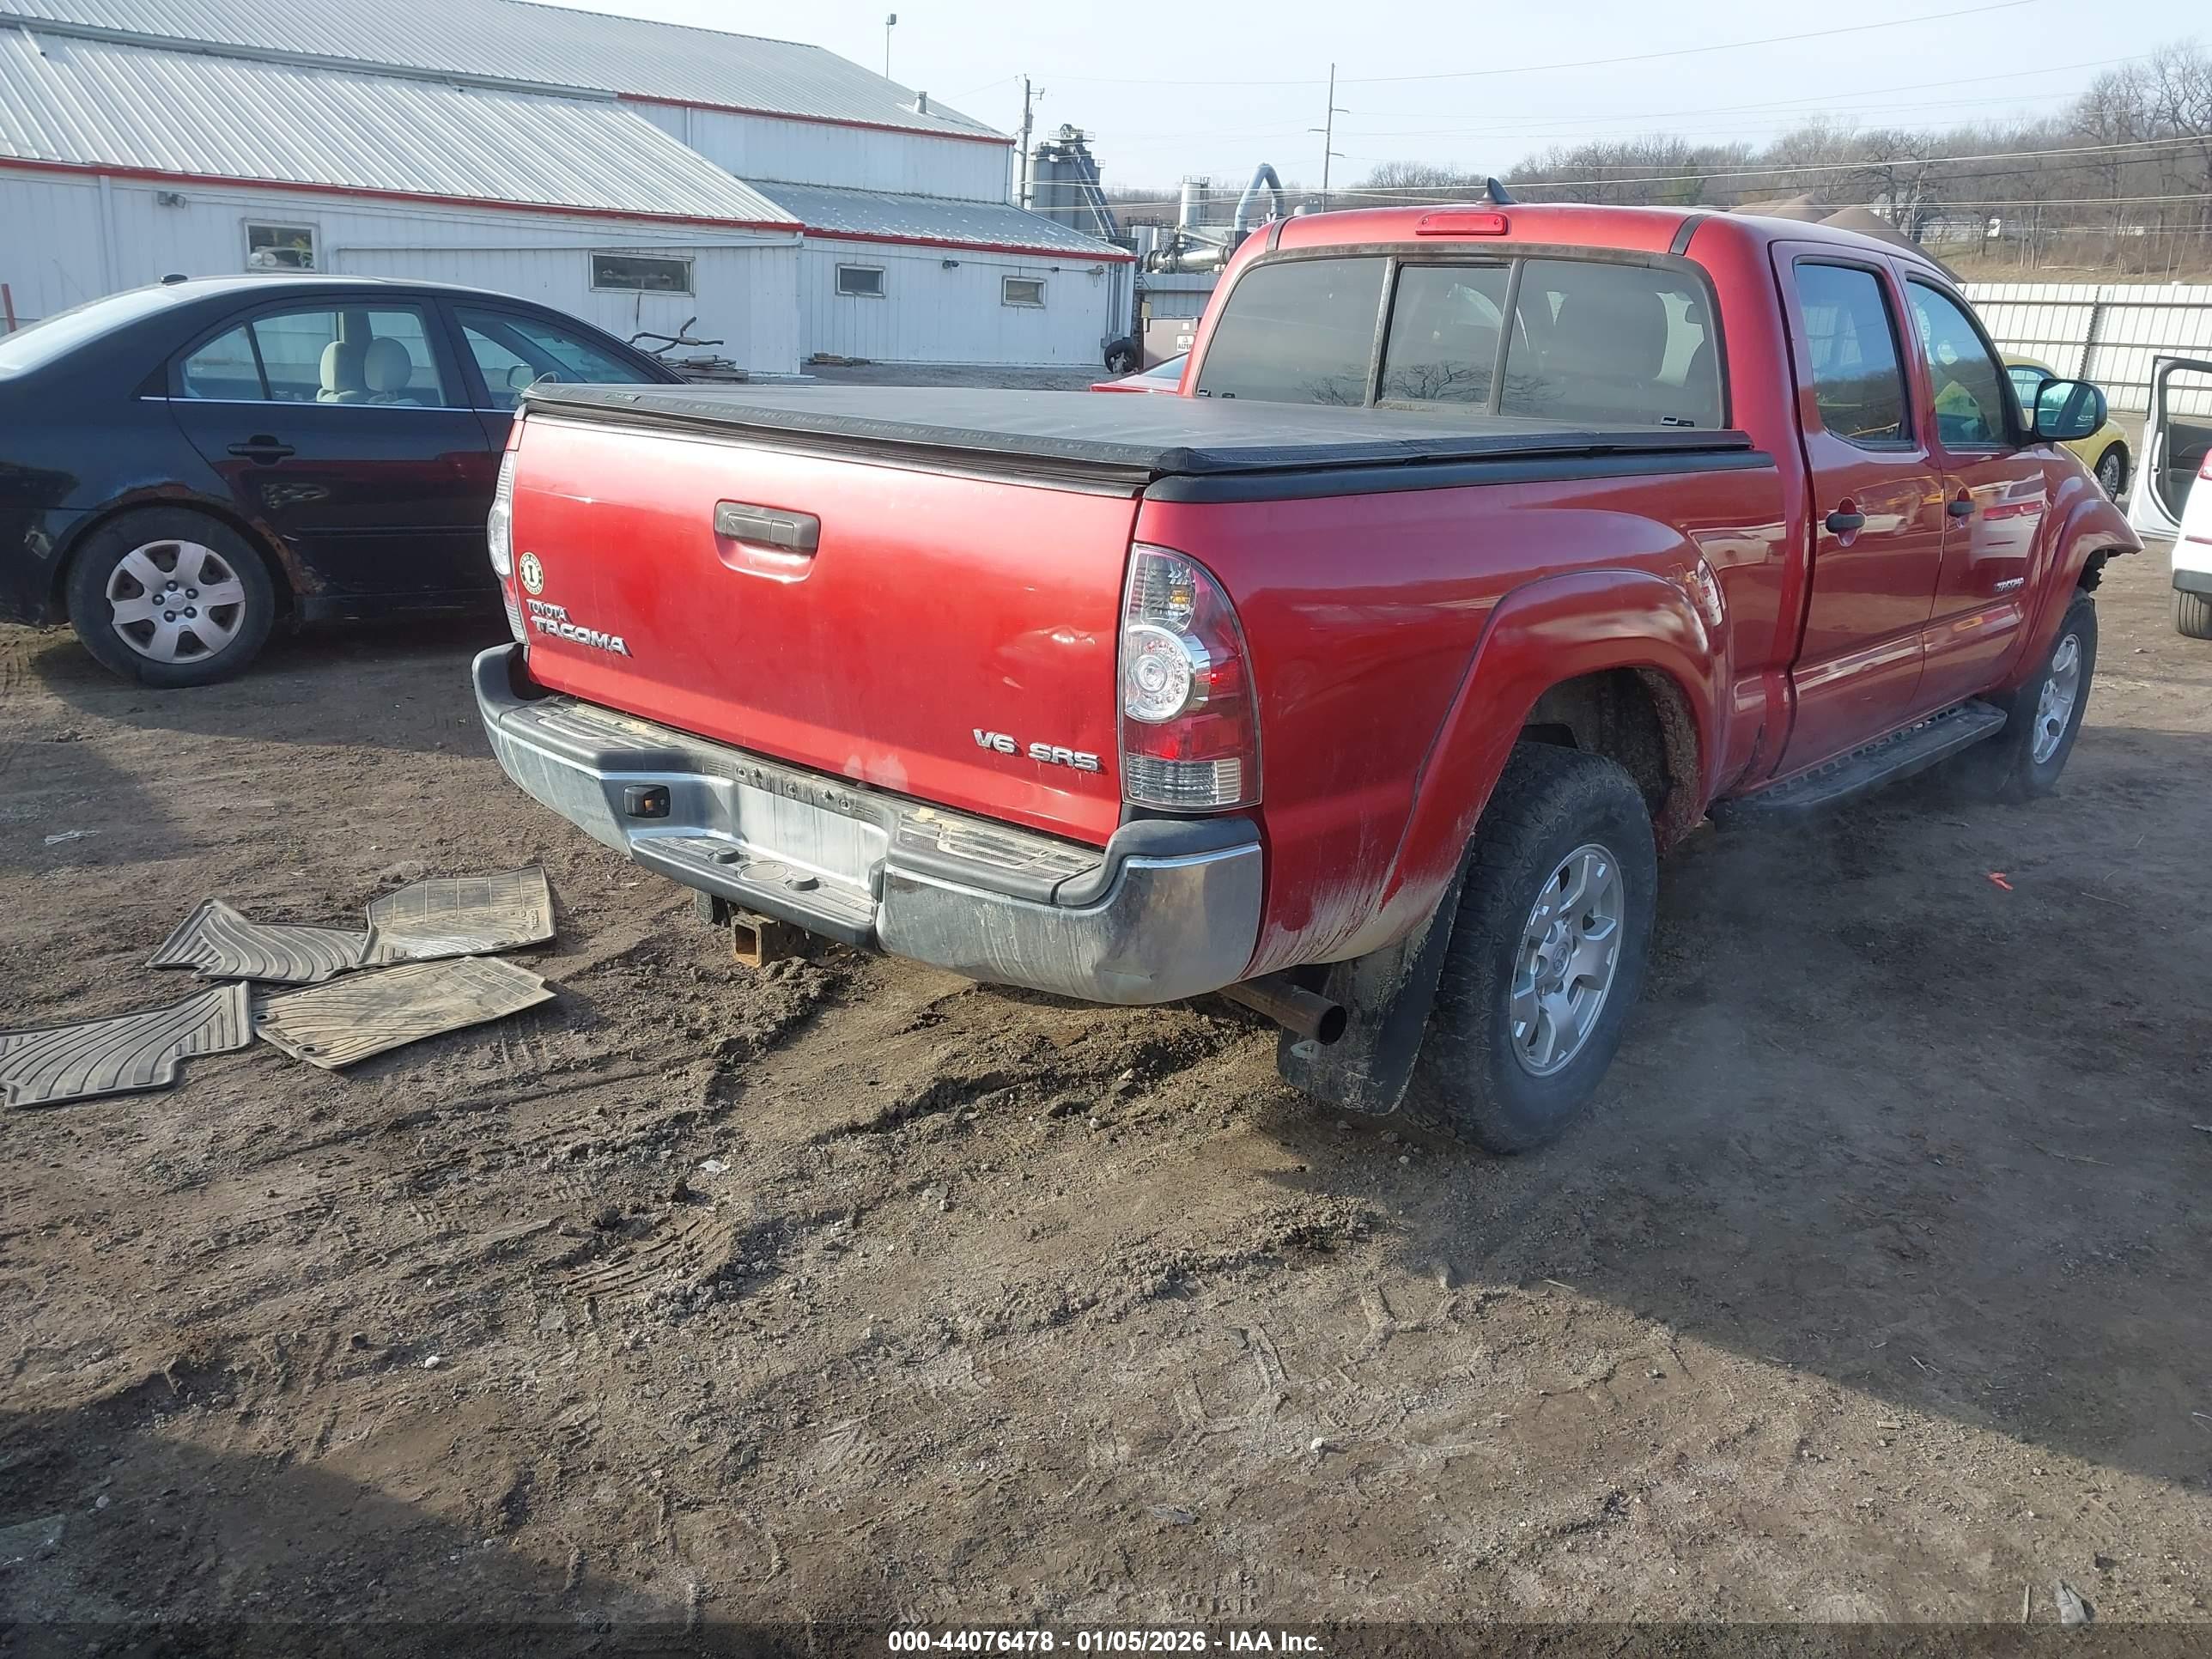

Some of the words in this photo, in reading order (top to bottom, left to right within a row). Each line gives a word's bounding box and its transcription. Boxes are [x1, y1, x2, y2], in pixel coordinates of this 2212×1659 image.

[526, 599, 568, 621] TOYOTA
[530, 616, 628, 657] TACOMA
[973, 728, 1016, 754] V6
[1028, 742, 1100, 772] SR5
